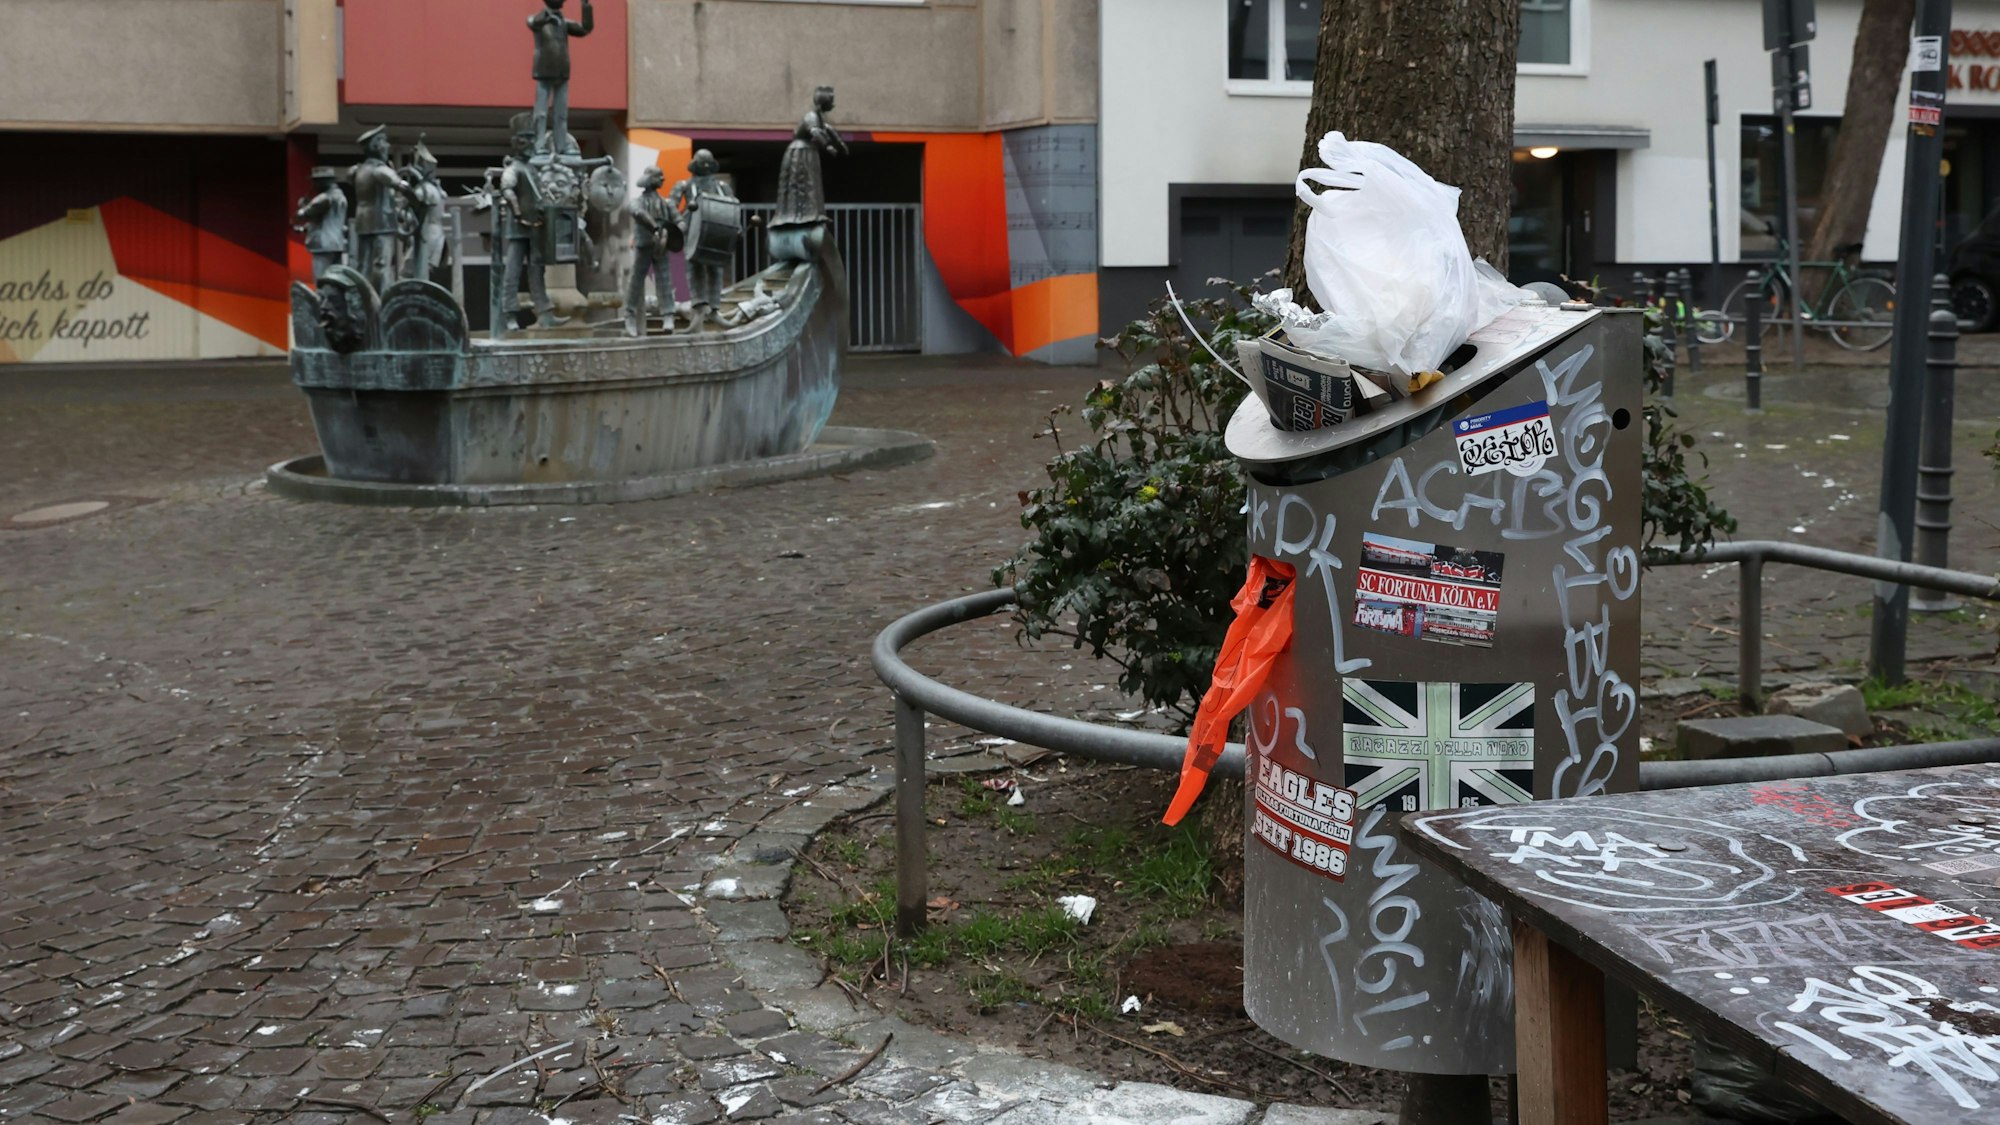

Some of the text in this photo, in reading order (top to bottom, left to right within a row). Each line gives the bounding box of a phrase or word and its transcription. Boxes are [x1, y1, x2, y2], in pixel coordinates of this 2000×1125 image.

[76, 270, 114, 300] do
[50, 308, 149, 348] kapott
[1359, 572, 1496, 610] SC FORTUNA KÖLN e.V.
[1350, 736, 1530, 757] RAGAZZI DELLA NORD
[1258, 755, 1356, 823] EAGLES
[1401, 795, 1479, 812] 19 85
[1279, 802, 1321, 831] FORTUNA
[1320, 820, 1350, 841] KÖLN
[1254, 807, 1347, 876] SEIT 1986
